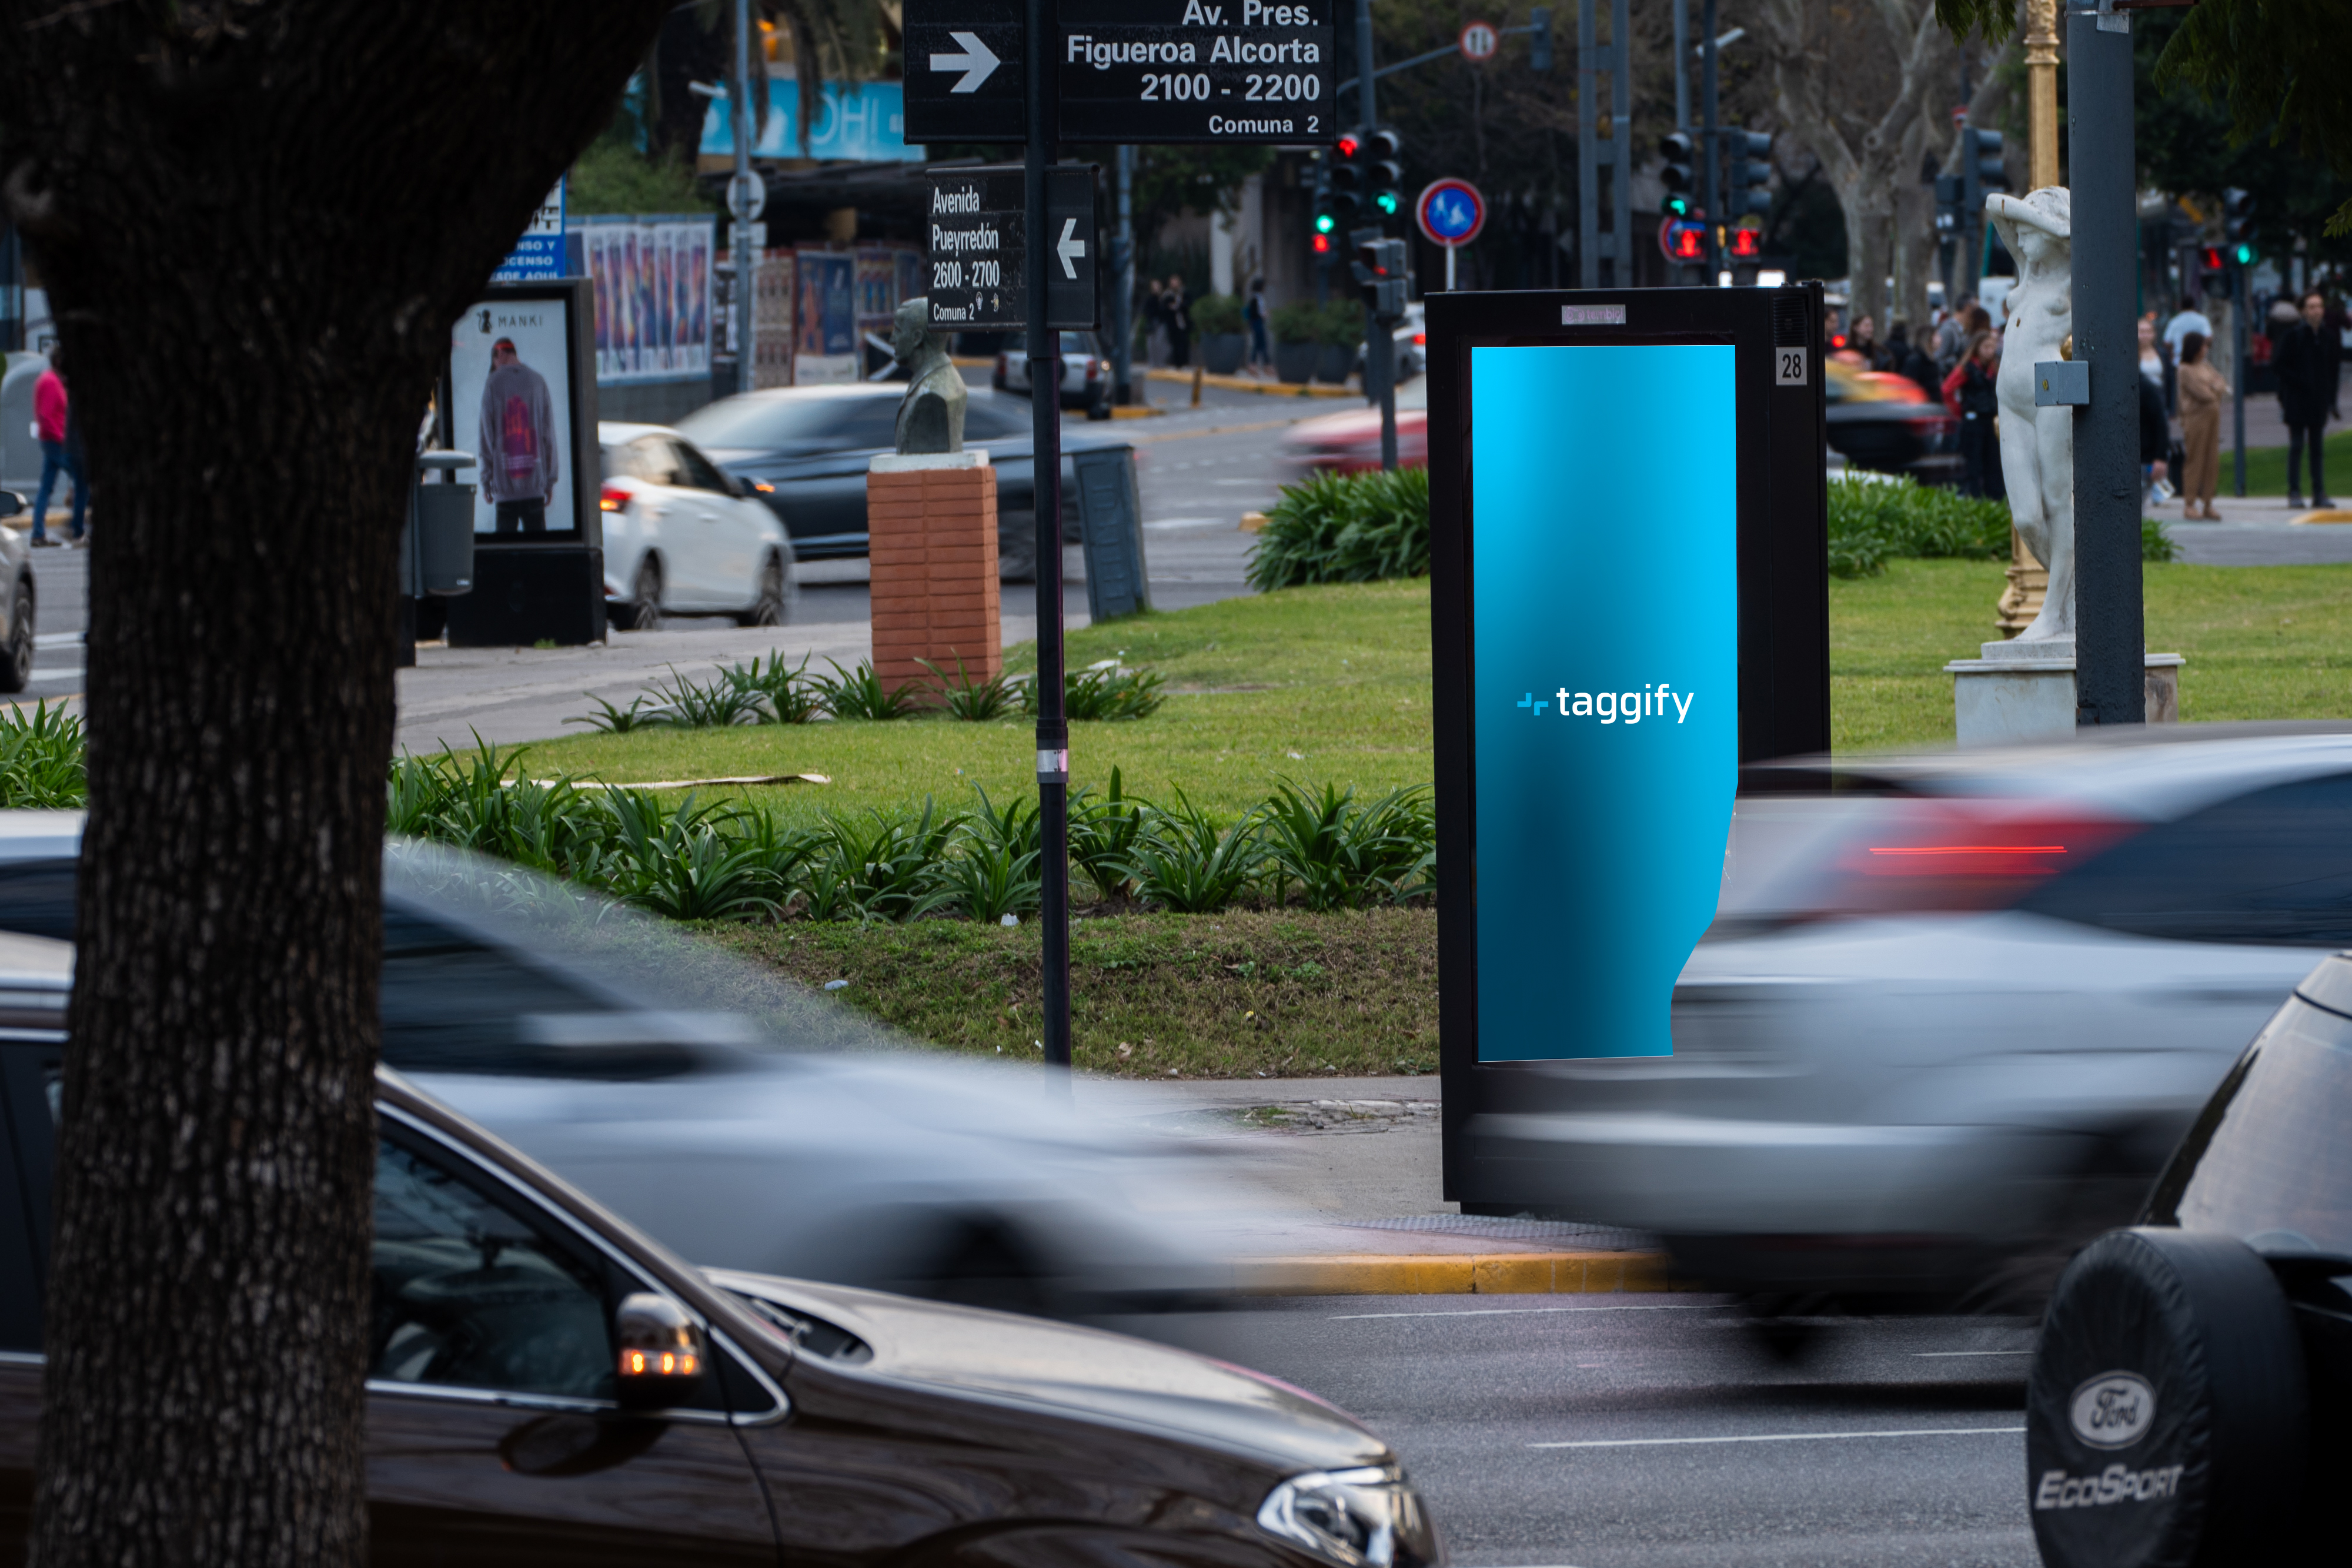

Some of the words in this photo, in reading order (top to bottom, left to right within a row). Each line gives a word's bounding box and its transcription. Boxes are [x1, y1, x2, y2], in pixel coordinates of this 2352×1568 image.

[1181, 0, 1228, 25] Av.
[1244, 0, 1319, 25] Pres.
[1068, 35, 1195, 70] Figueroa
[1210, 36, 1319, 63] Alcorta
[1141, 74, 1210, 101] 2100
[1245, 74, 1320, 101] 2200
[1209, 115, 1293, 133] Comuna
[1307, 116, 1319, 133] 2
[933, 185, 980, 213] Avenida
[933, 222, 998, 257] Pueyrredón
[933, 261, 961, 288] 2600
[972, 260, 1000, 287] 2700
[498, 315, 543, 327] MANKI
[934, 303, 966, 322] Comuna
[969, 303, 974, 320] 2
[1782, 353, 1802, 378] 28
[1556, 684, 1694, 724] taggify
[2090, 1387, 2140, 1429] Ford
